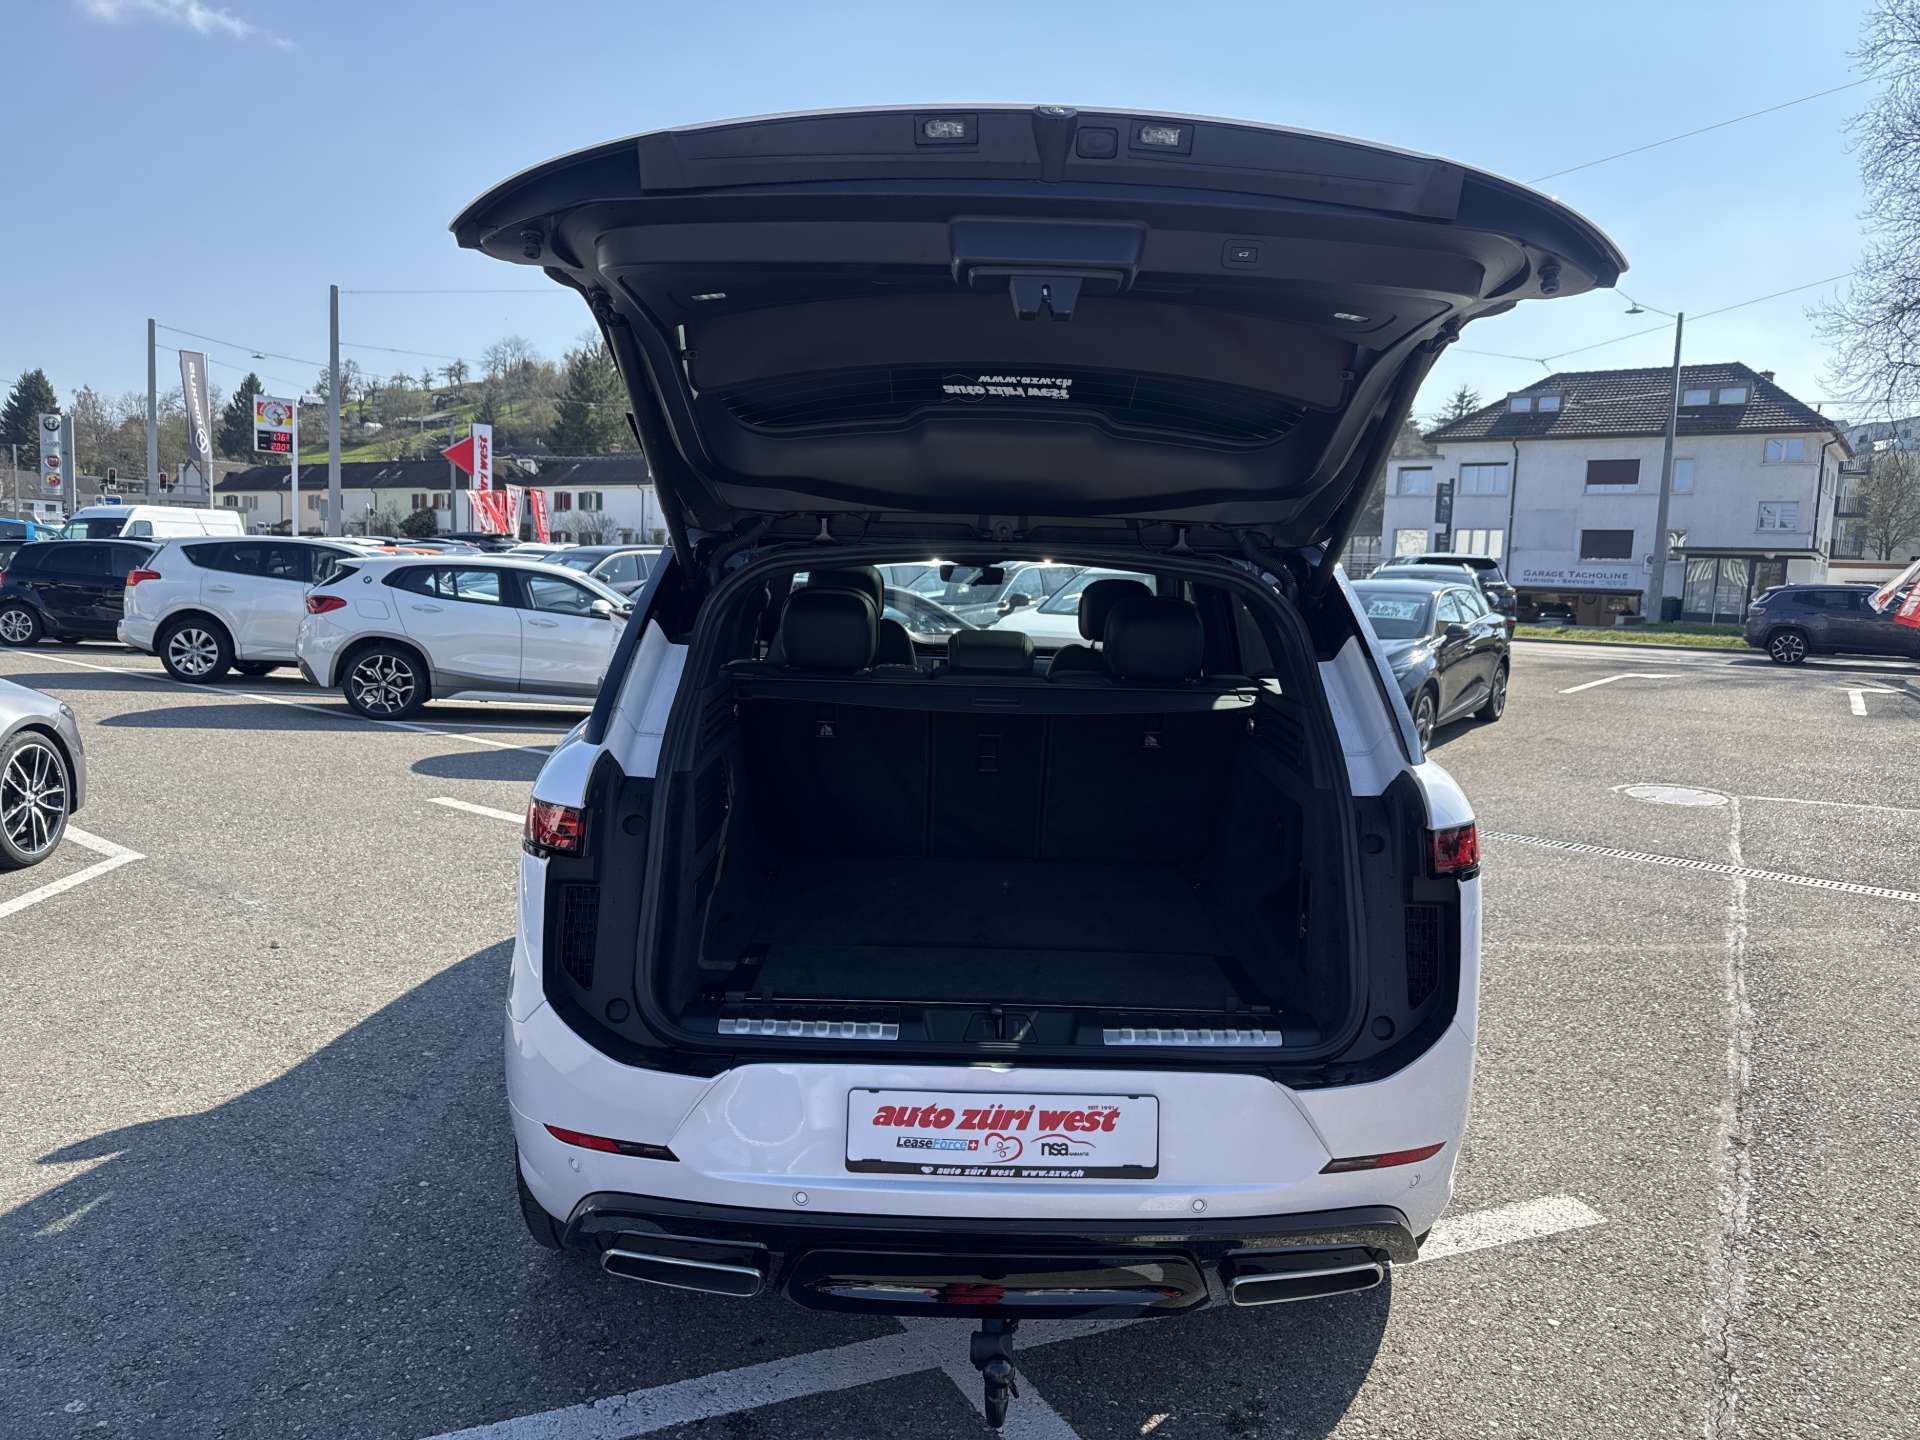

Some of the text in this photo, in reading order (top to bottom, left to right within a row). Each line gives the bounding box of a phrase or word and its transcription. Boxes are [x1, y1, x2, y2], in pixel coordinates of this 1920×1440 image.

[479, 435, 488, 470] west
[1523, 569, 1629, 580] GARAGE TACHOLINE
[872, 1103, 1121, 1132] auto züri west
[896, 1137, 967, 1151] LeaseForce
[1041, 1142, 1069, 1156] nsa
[937, 1167, 962, 1175] auto
[963, 1167, 987, 1176] züri
[990, 1168, 1016, 1177] west
